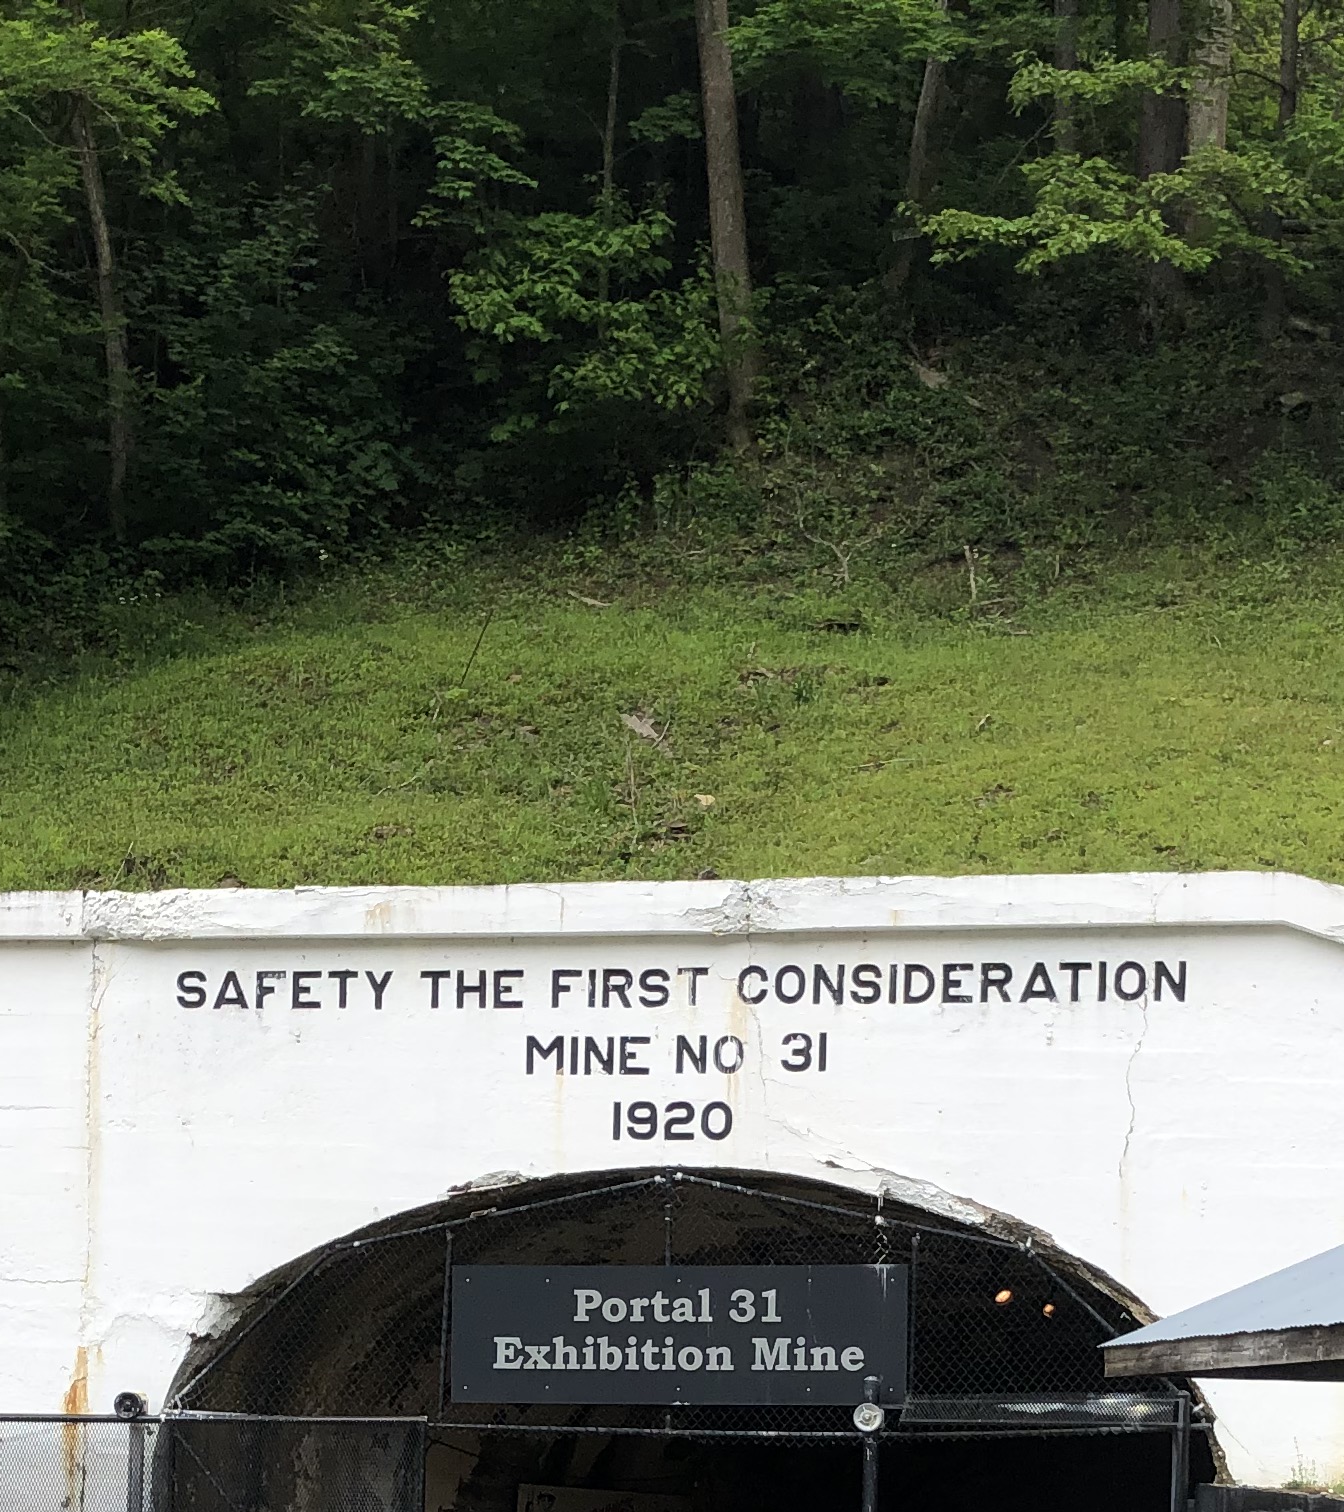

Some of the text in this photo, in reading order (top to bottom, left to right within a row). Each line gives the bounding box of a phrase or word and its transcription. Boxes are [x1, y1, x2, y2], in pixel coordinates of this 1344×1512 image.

[175, 960, 1188, 1010] SAFETY THE FIRST CONSIDERATION
[526, 1032, 827, 1076] MINE NO 31
[612, 1100, 733, 1141] 1920
[572, 1287, 782, 1323] Portal 31
[492, 1336, 865, 1372] Exhibition Mine
